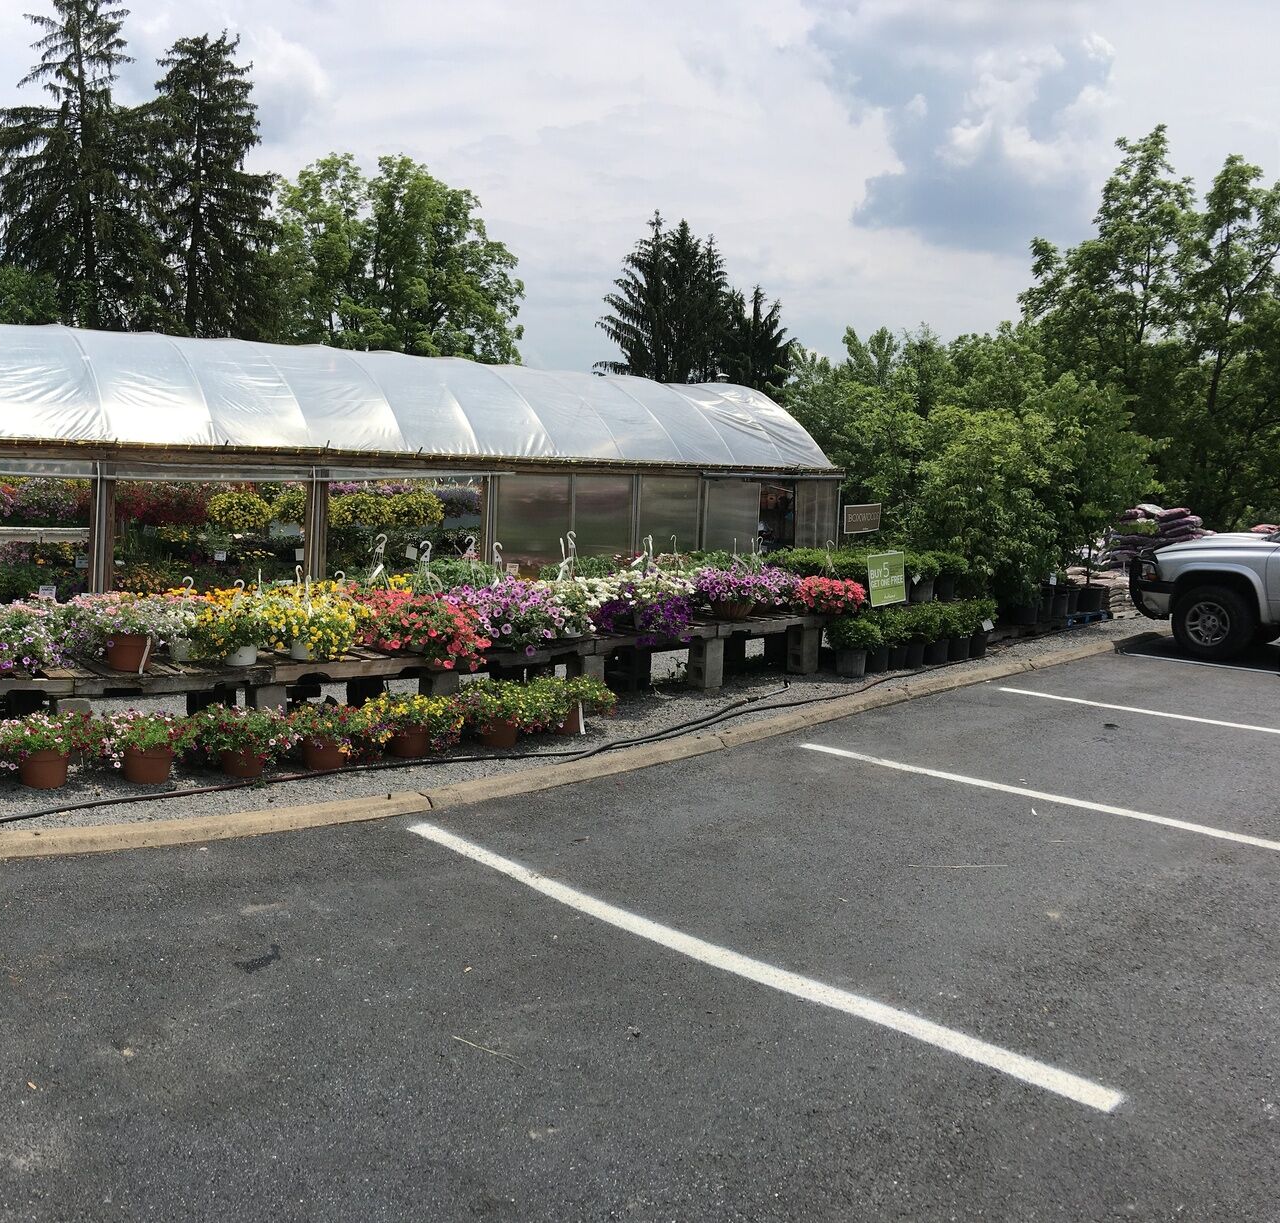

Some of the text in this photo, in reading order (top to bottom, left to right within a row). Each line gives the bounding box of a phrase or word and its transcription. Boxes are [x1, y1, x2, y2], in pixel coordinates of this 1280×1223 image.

[870, 567, 883, 579] BUY
[883, 562, 889, 578] 5
[871, 574, 904, 588] GET ONE FREE
